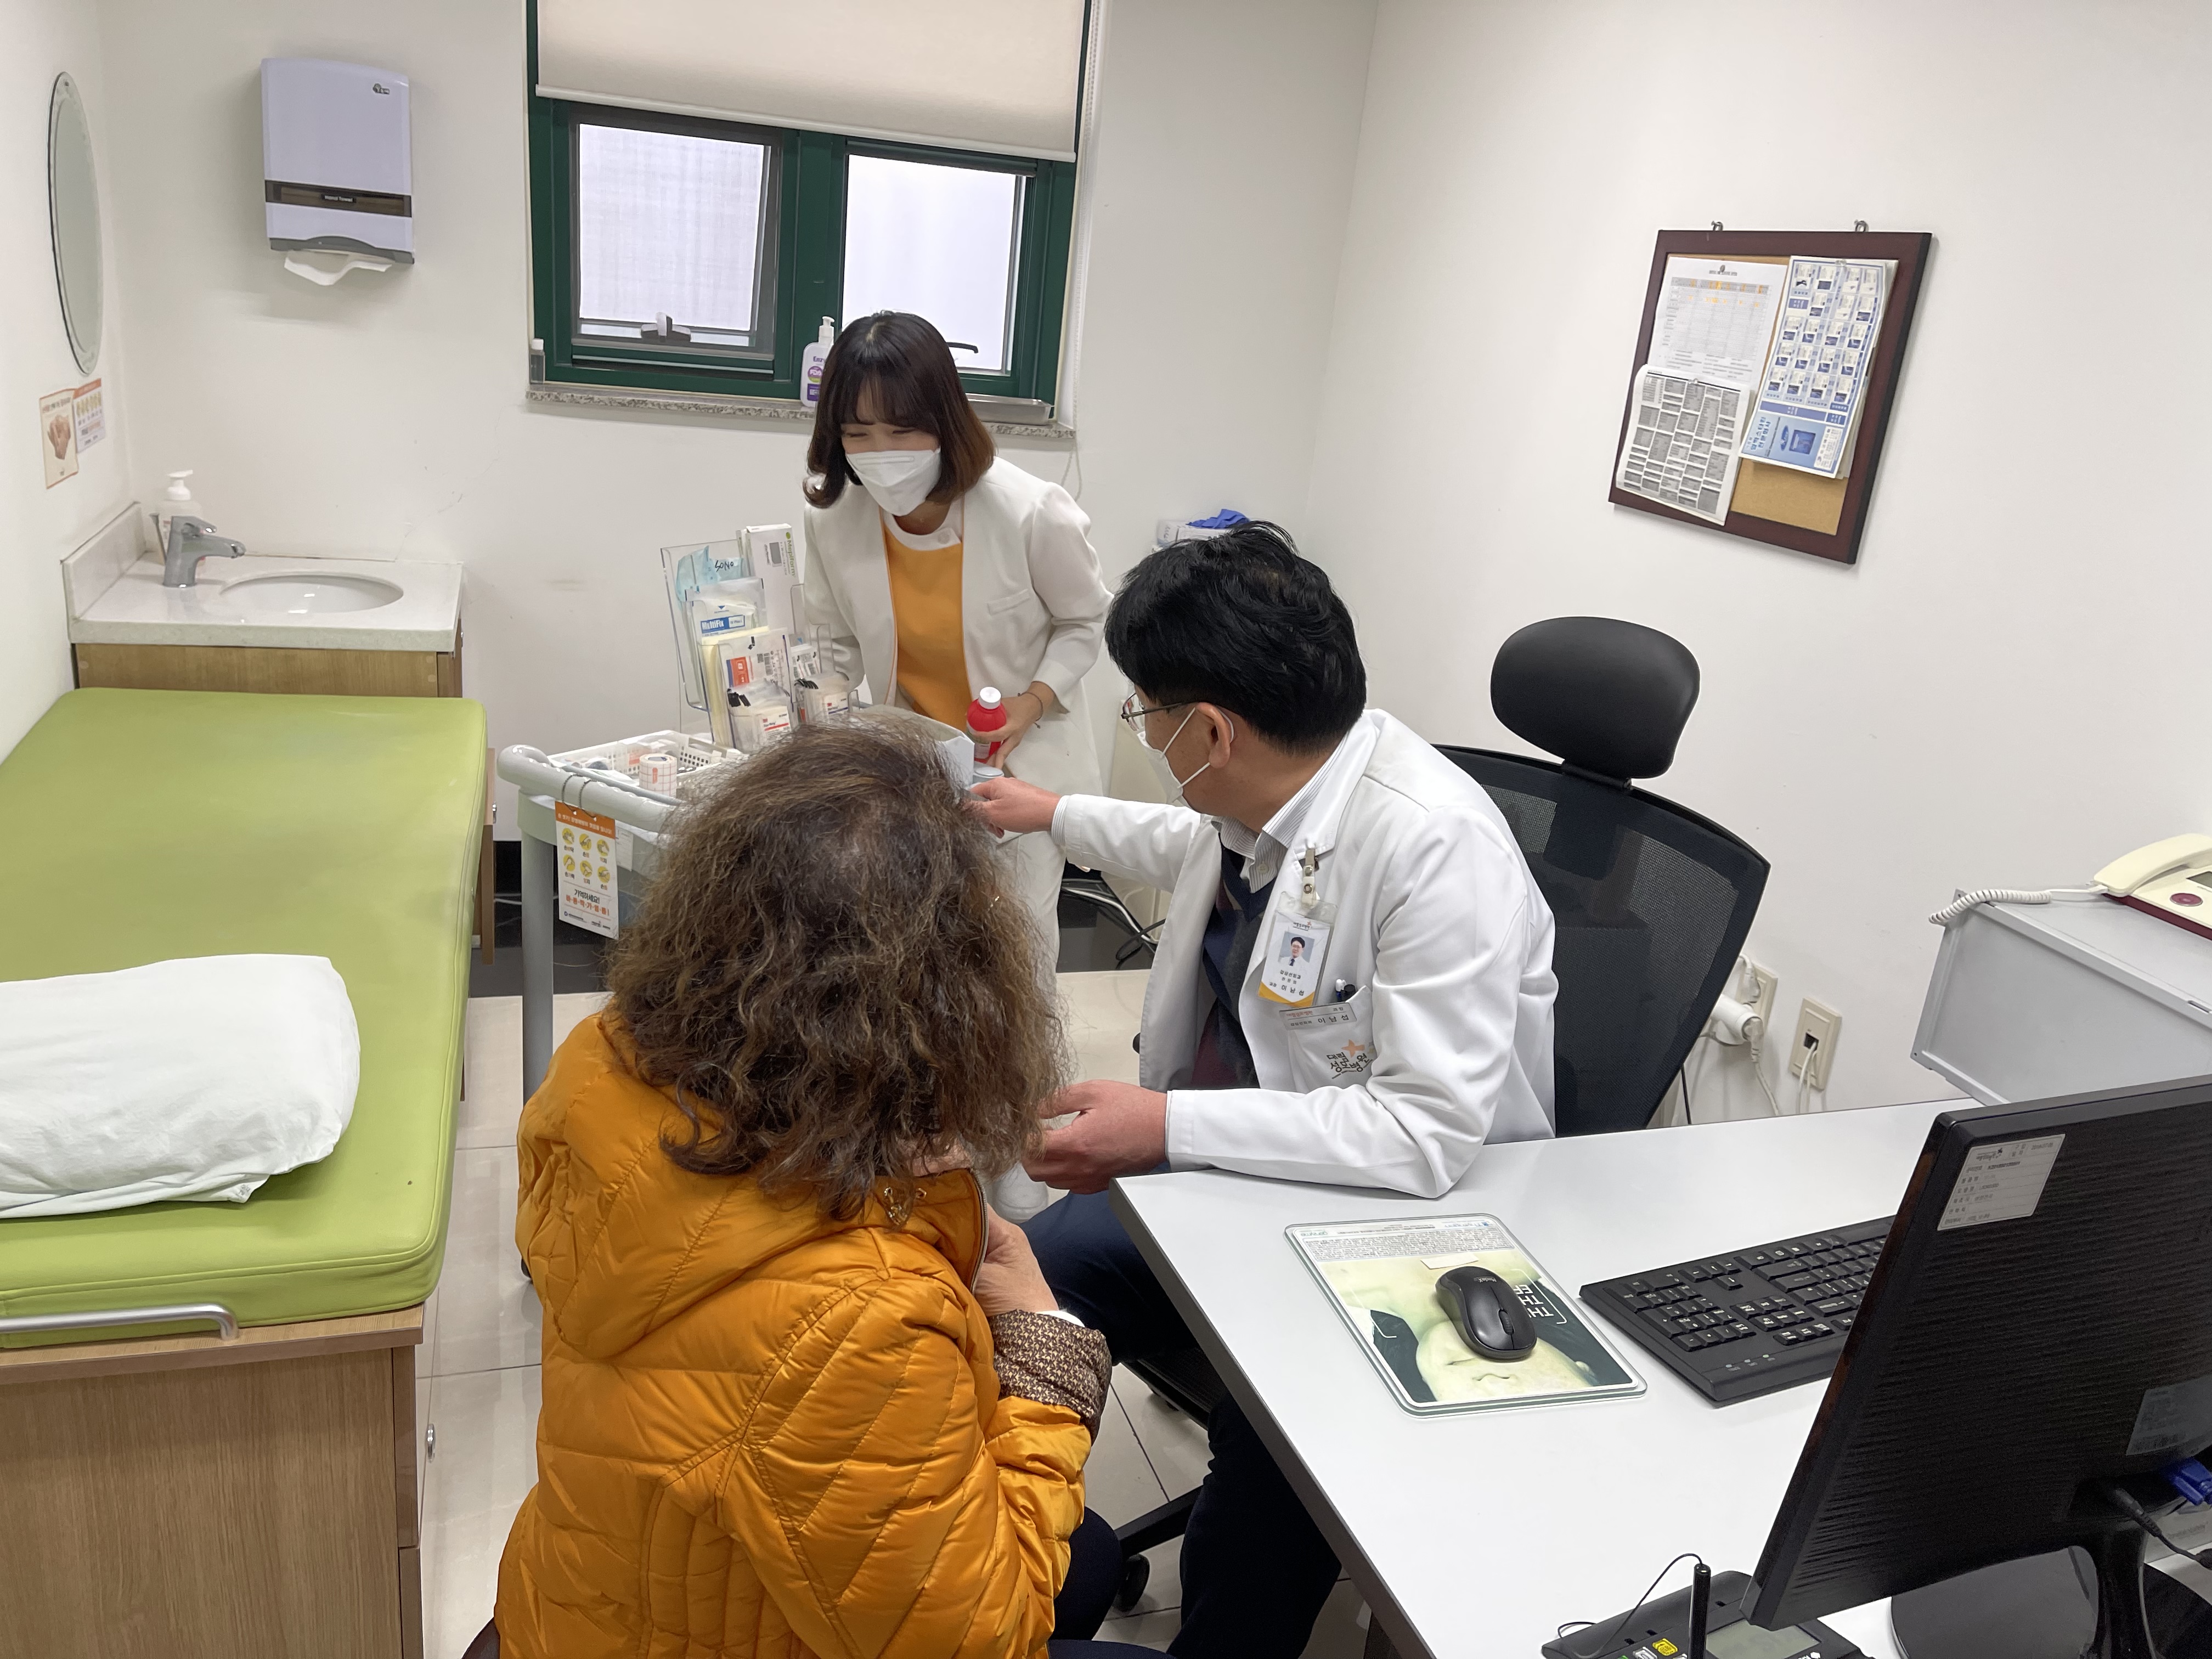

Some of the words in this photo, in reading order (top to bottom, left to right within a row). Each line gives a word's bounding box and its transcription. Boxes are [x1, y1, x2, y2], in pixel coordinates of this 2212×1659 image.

[787, 540, 796, 577] Mepiform
[574, 889, 600, 904] 기억하세요!
[1326, 1052, 1350, 1064] 대림
[1527, 1306, 1554, 1318] TH
